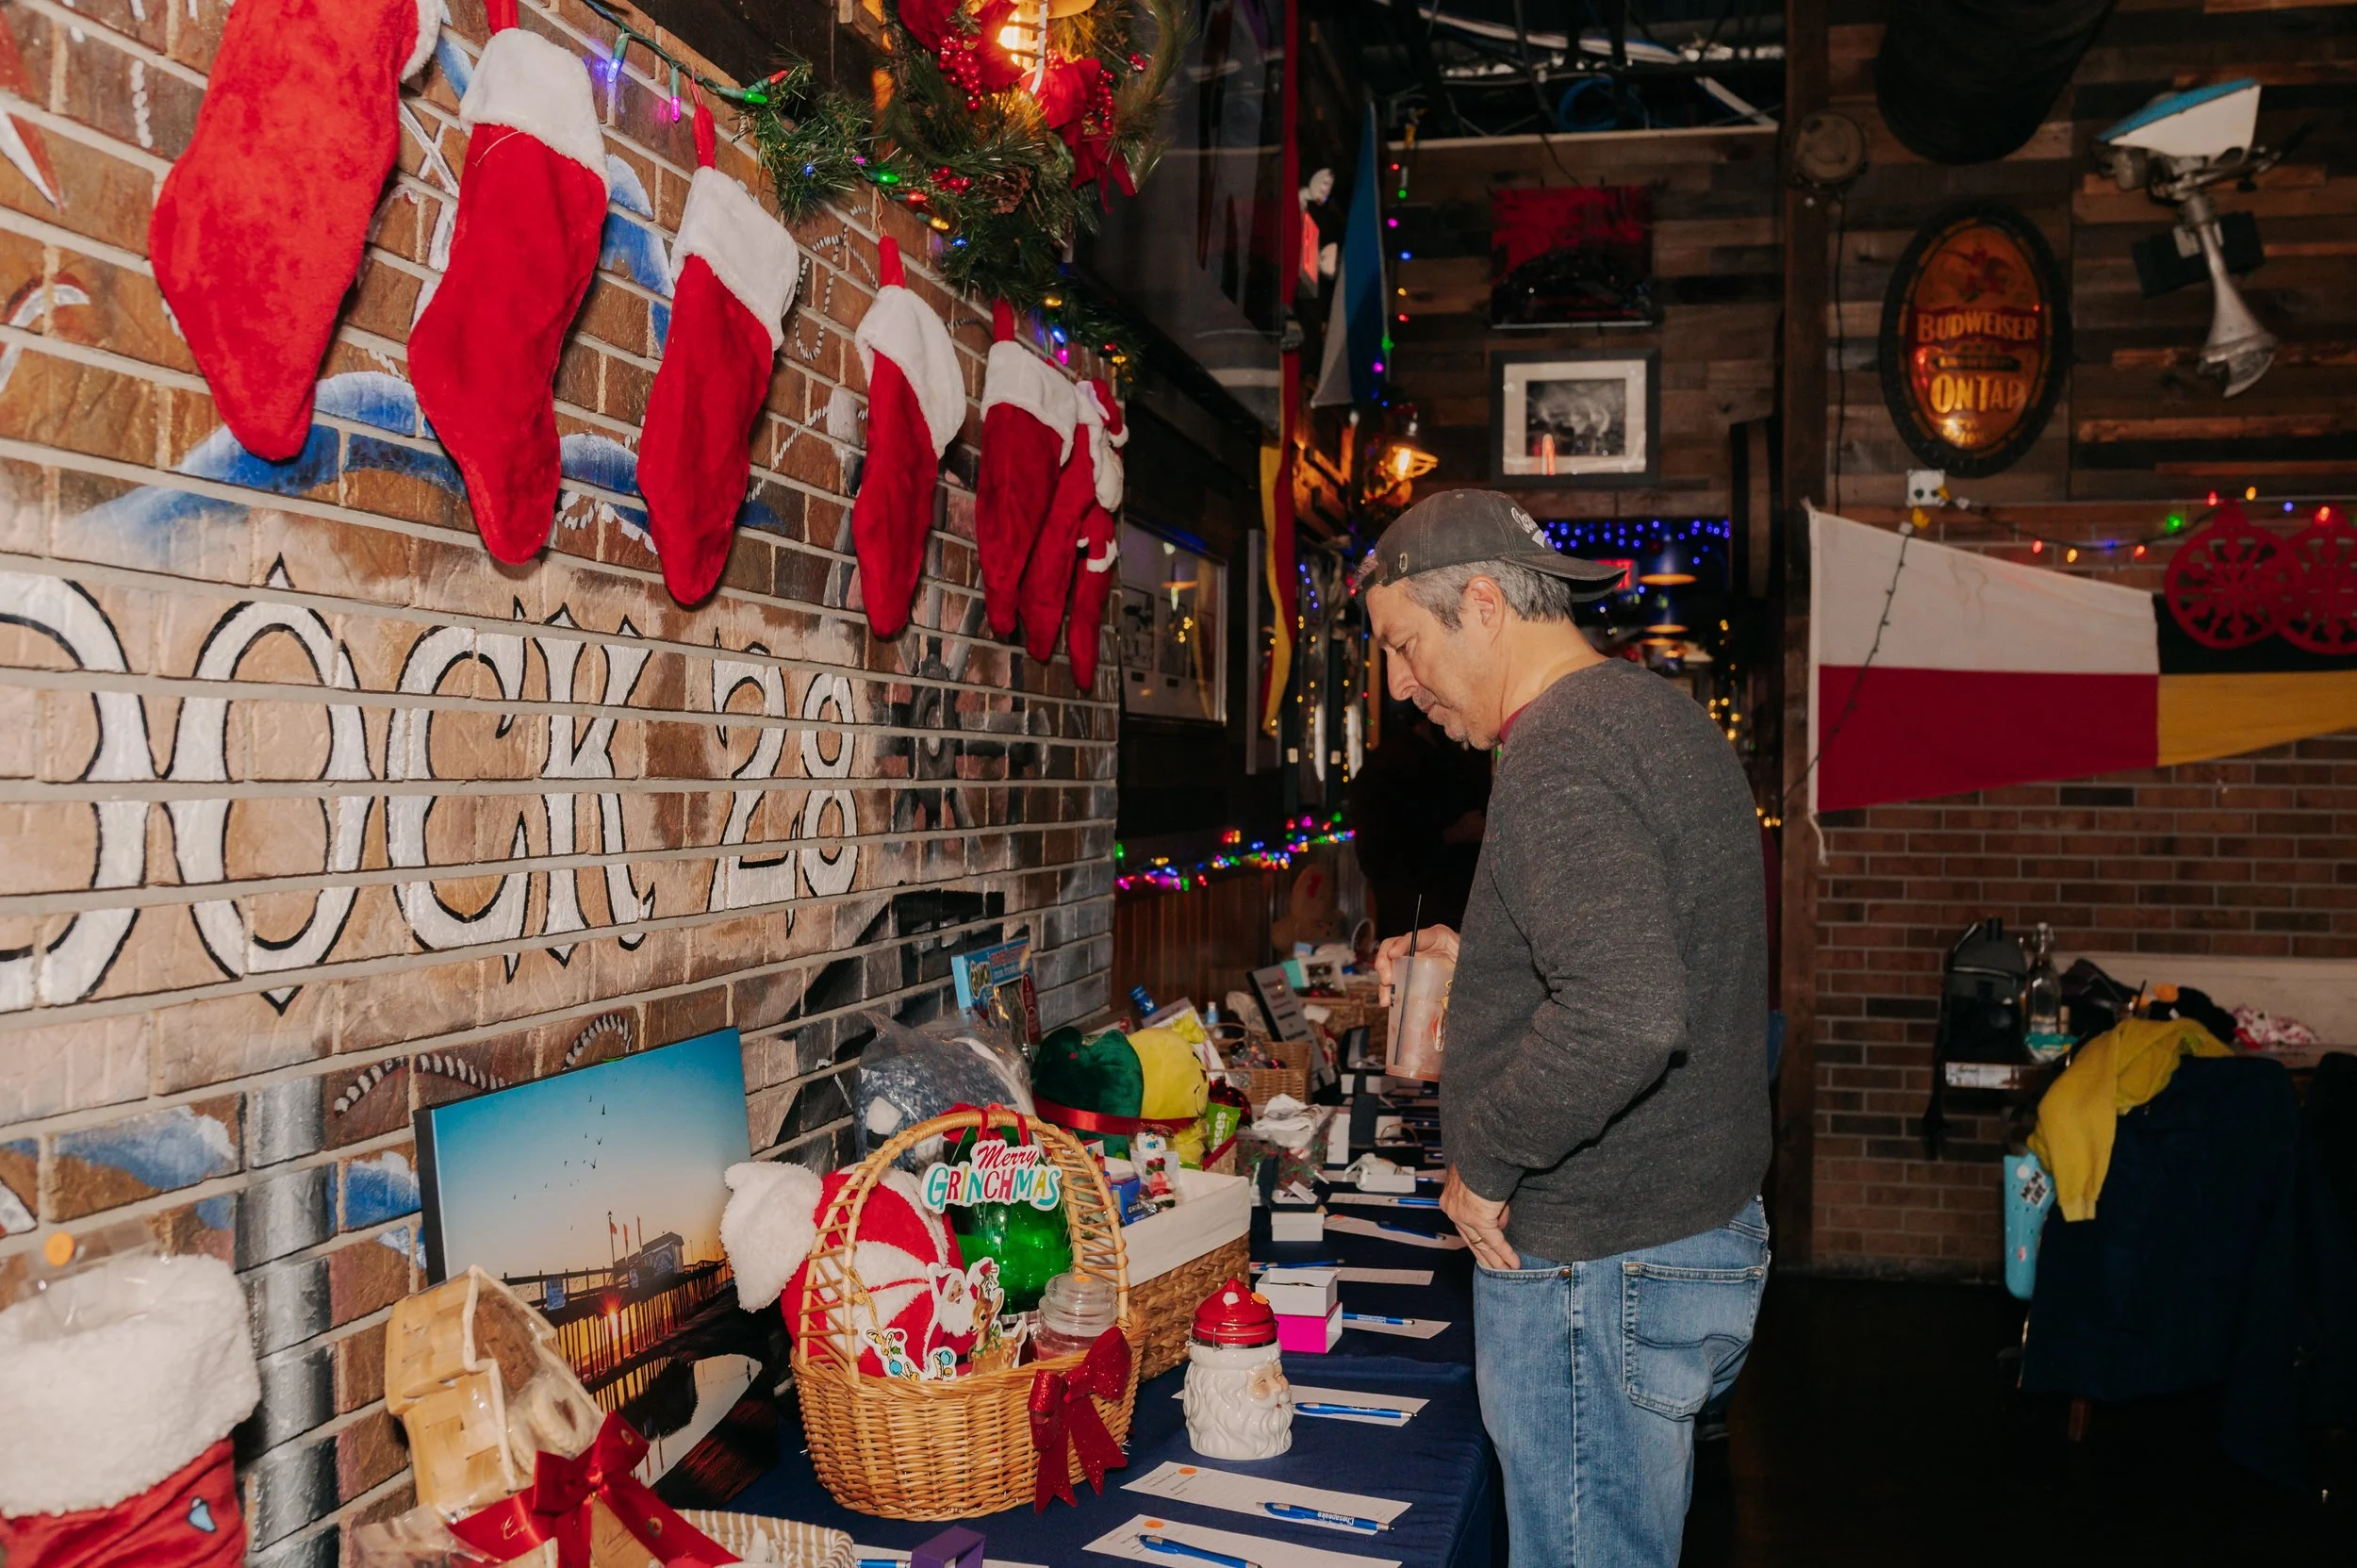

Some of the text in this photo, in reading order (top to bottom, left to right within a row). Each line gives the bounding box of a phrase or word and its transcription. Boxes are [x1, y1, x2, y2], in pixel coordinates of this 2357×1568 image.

[1917, 310, 2038, 342] BUDWEISER
[1929, 373, 2026, 414] ON TAP
[707, 627, 858, 939] 28
[977, 1144, 1039, 1170] Merry
[926, 1165, 1062, 1211] GRINCHMAS
